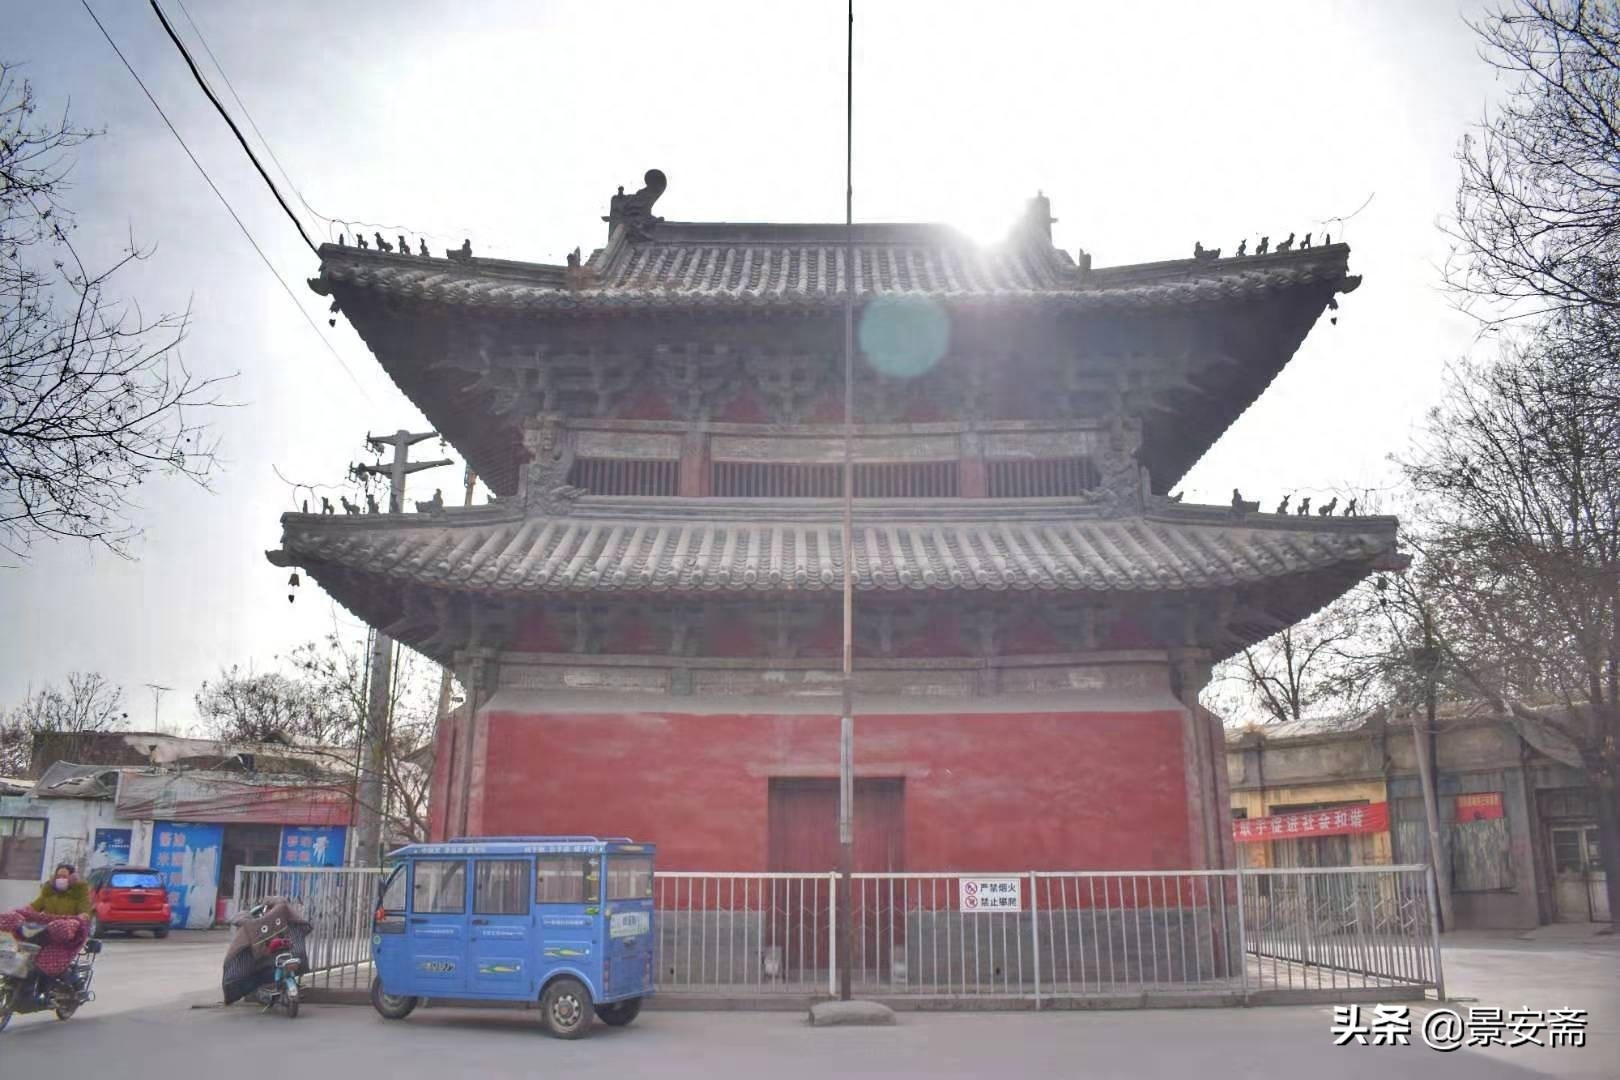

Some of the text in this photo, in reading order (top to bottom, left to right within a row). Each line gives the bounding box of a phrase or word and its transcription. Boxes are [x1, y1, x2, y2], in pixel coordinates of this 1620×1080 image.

[980, 883, 1016, 893] 严禁烟火
[980, 897, 1016, 907] 禁止攀爬
